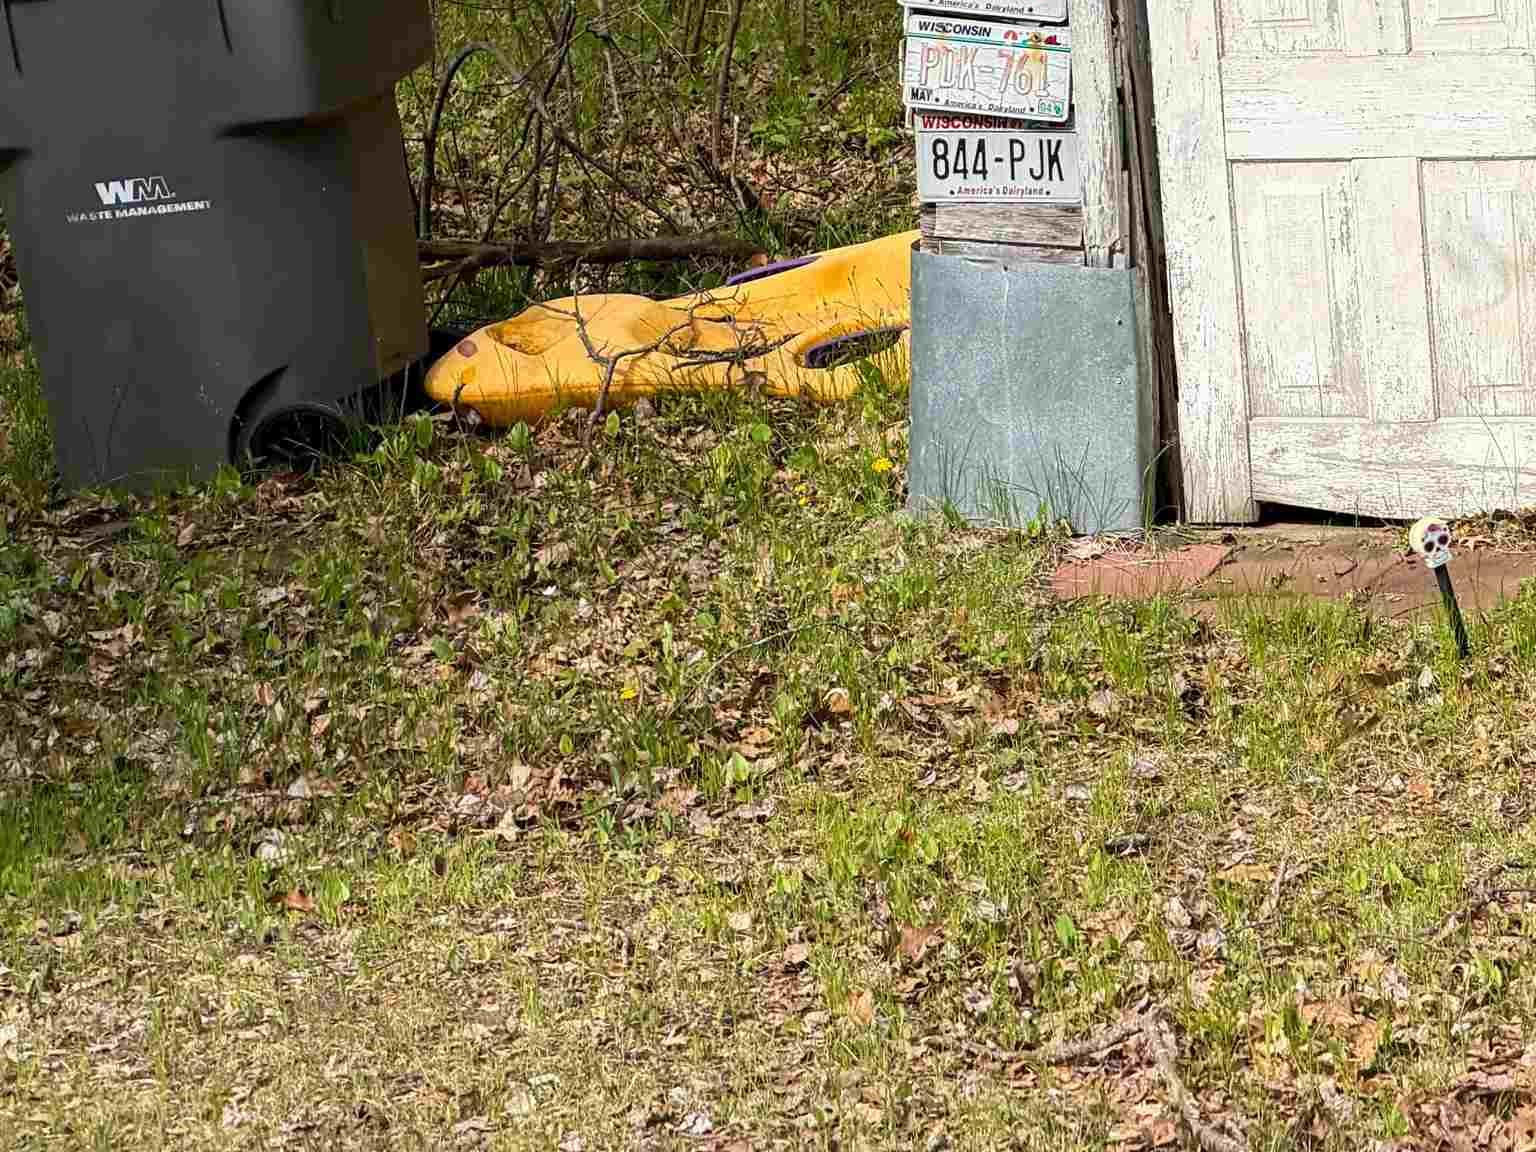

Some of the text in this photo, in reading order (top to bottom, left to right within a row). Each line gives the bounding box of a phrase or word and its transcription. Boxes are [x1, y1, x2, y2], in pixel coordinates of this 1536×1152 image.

[918, 21, 992, 36] WISCONSIN
[911, 88, 933, 100] MAY
[944, 99, 982, 110] America's
[922, 116, 1008, 129] WISCONSIN
[932, 138, 1064, 181] 844-PJK
[957, 186, 1043, 197] America's Dairyland
[66, 200, 211, 223] WASTE MANAGEMENT
